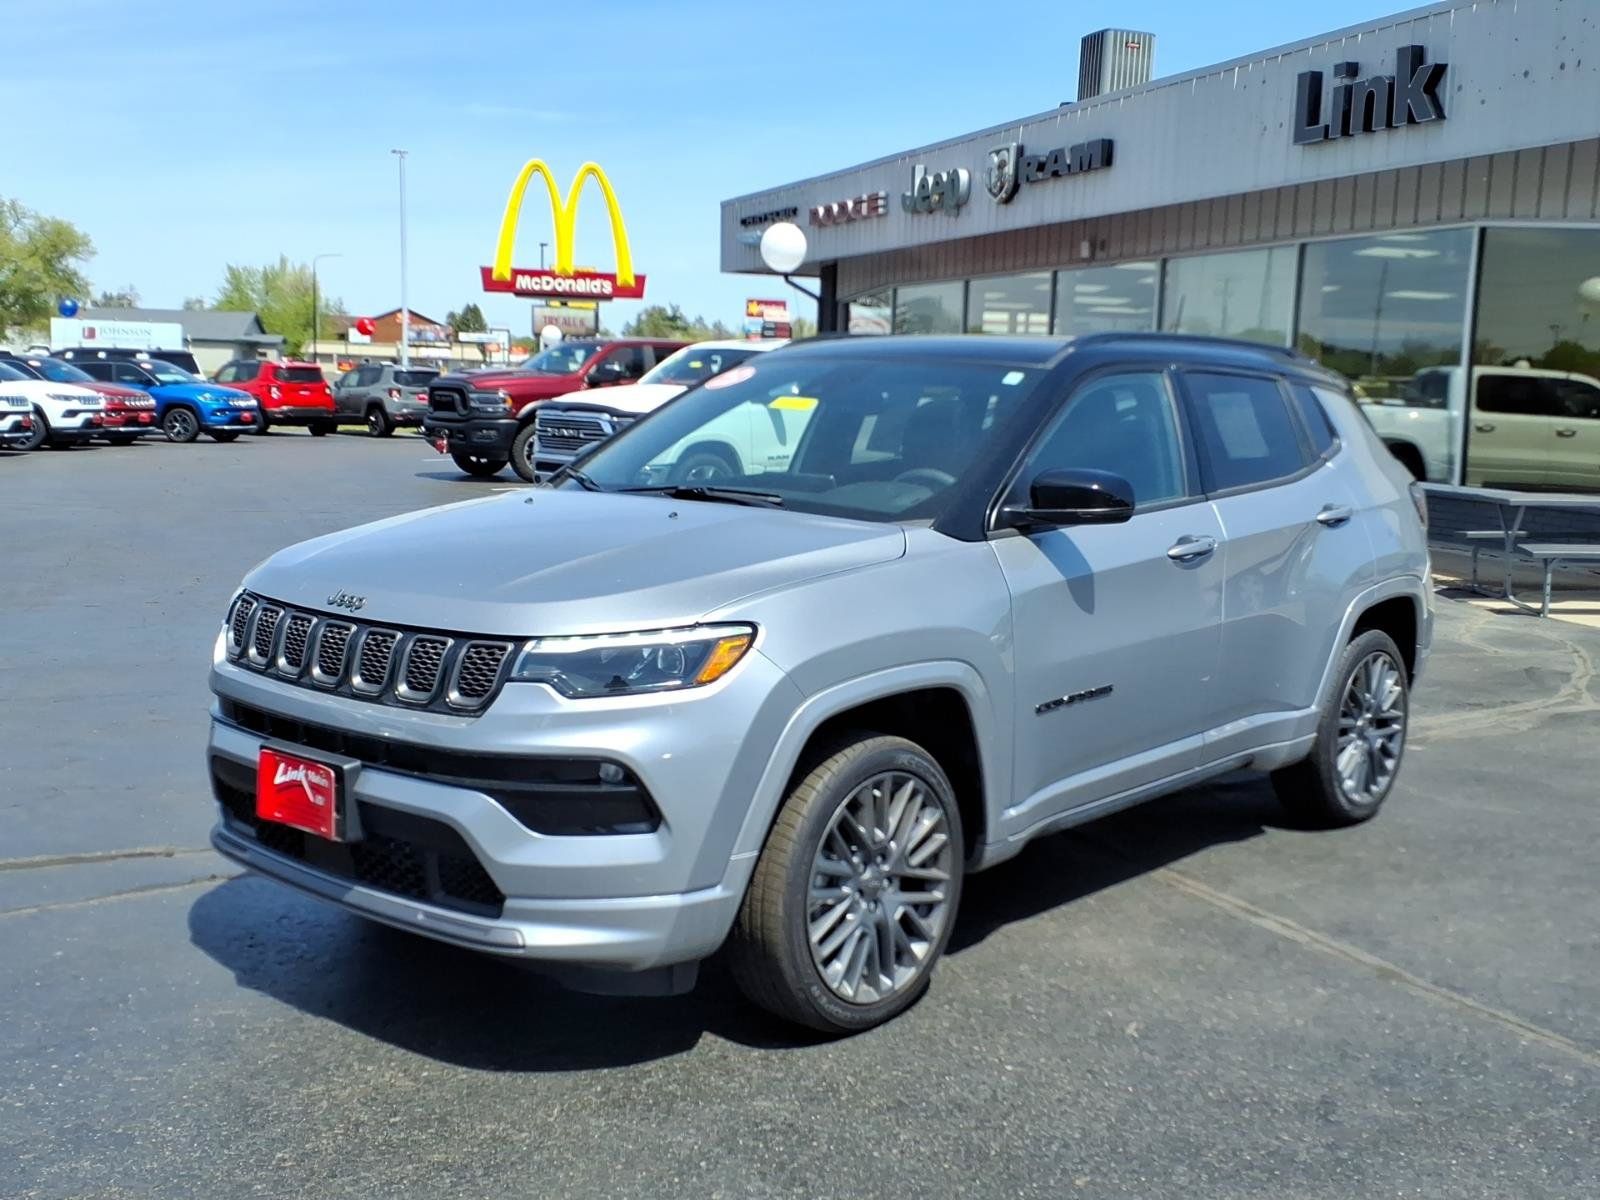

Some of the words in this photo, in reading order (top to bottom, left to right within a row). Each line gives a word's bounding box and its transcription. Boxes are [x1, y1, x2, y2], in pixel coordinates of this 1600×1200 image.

[1293, 45, 1448, 145] Link
[1019, 138, 1114, 183] RAM
[809, 190, 888, 228] DODGE
[901, 164, 971, 217] Jeep
[515, 274, 613, 294] McDonald's
[99, 327, 152, 336] JOHNSON
[327, 589, 366, 613] Jeep
